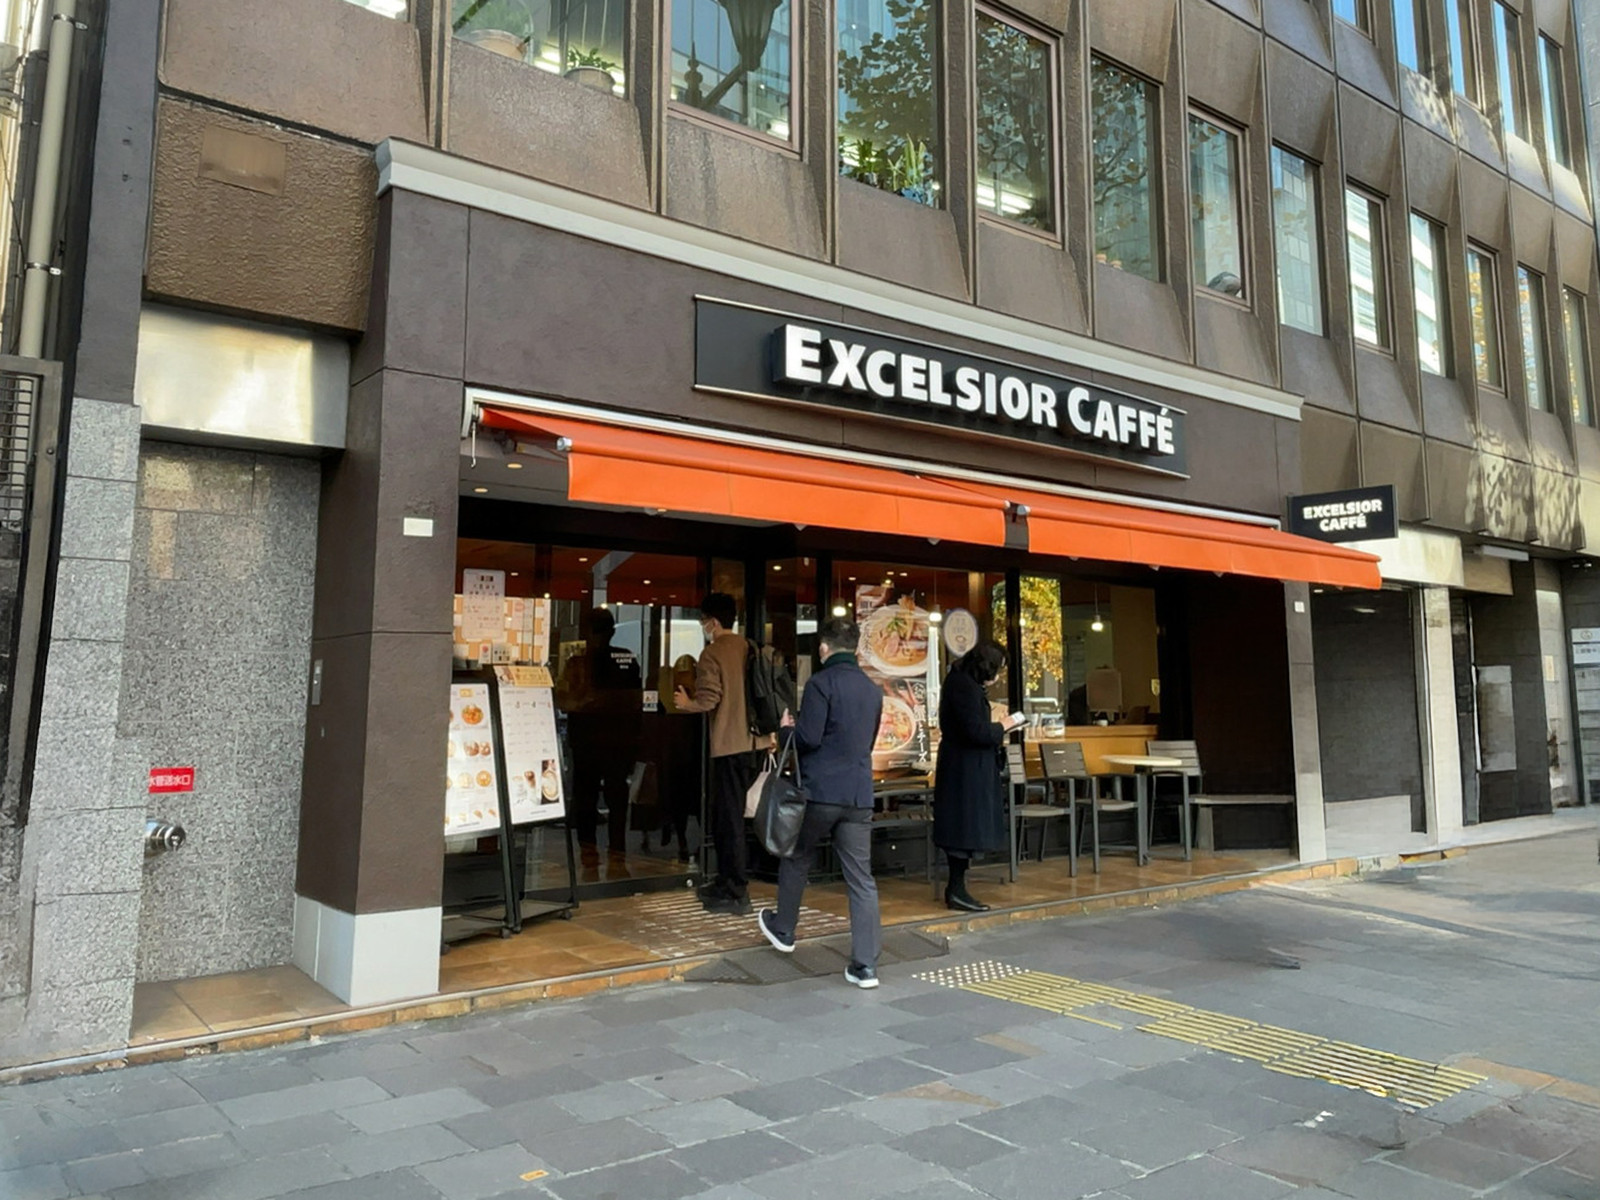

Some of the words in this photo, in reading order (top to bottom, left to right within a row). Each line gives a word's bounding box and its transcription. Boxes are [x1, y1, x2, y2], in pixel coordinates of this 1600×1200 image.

[784, 323, 1058, 428] EXCELSIOR
[1066, 386, 1175, 455] CAFFÉ
[1303, 499, 1382, 519] EXCELSIOR
[1319, 513, 1367, 532] CAFFÉ
